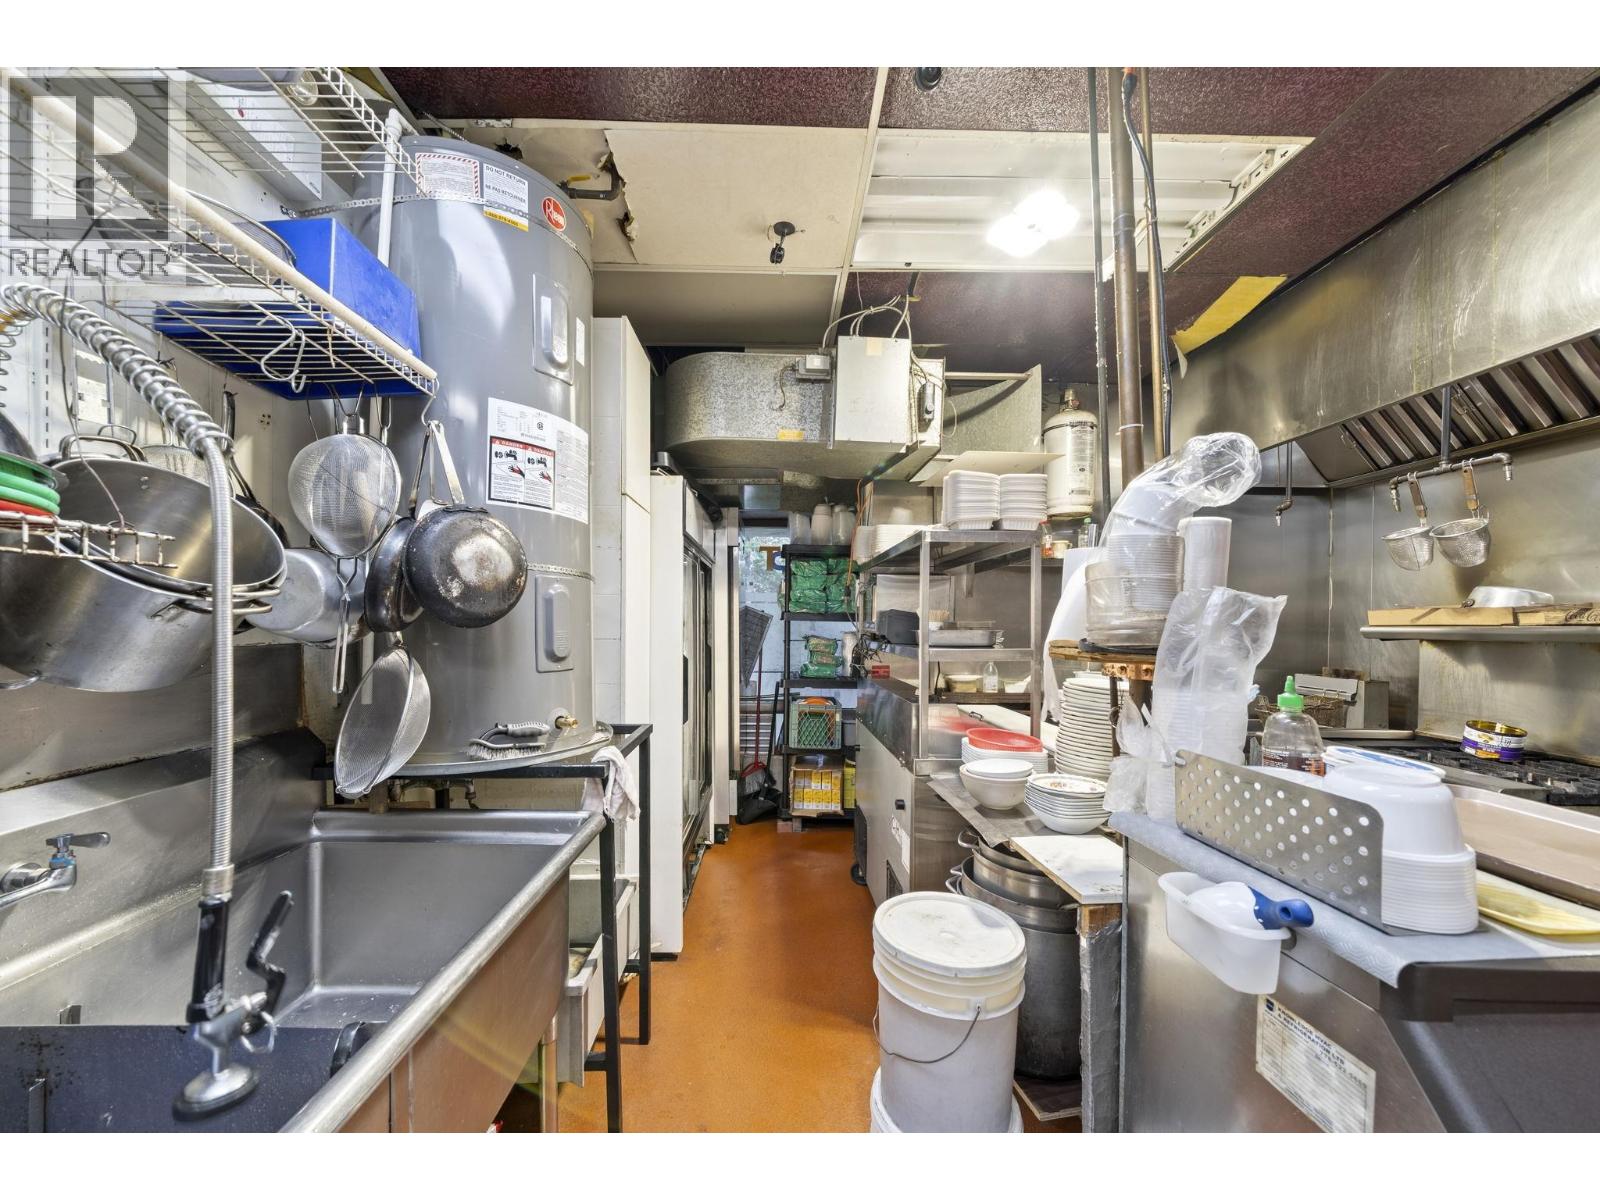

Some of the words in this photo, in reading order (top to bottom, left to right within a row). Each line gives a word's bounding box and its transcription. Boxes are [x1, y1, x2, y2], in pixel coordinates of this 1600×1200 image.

[494, 168, 505, 177] NOT
[506, 173, 526, 186] RETURN
[1278, 1007, 1313, 1035] KNOWLEDGE
[1283, 1016, 1331, 1054] REFRIGERATION
[1332, 1052, 1345, 1066] LTD
